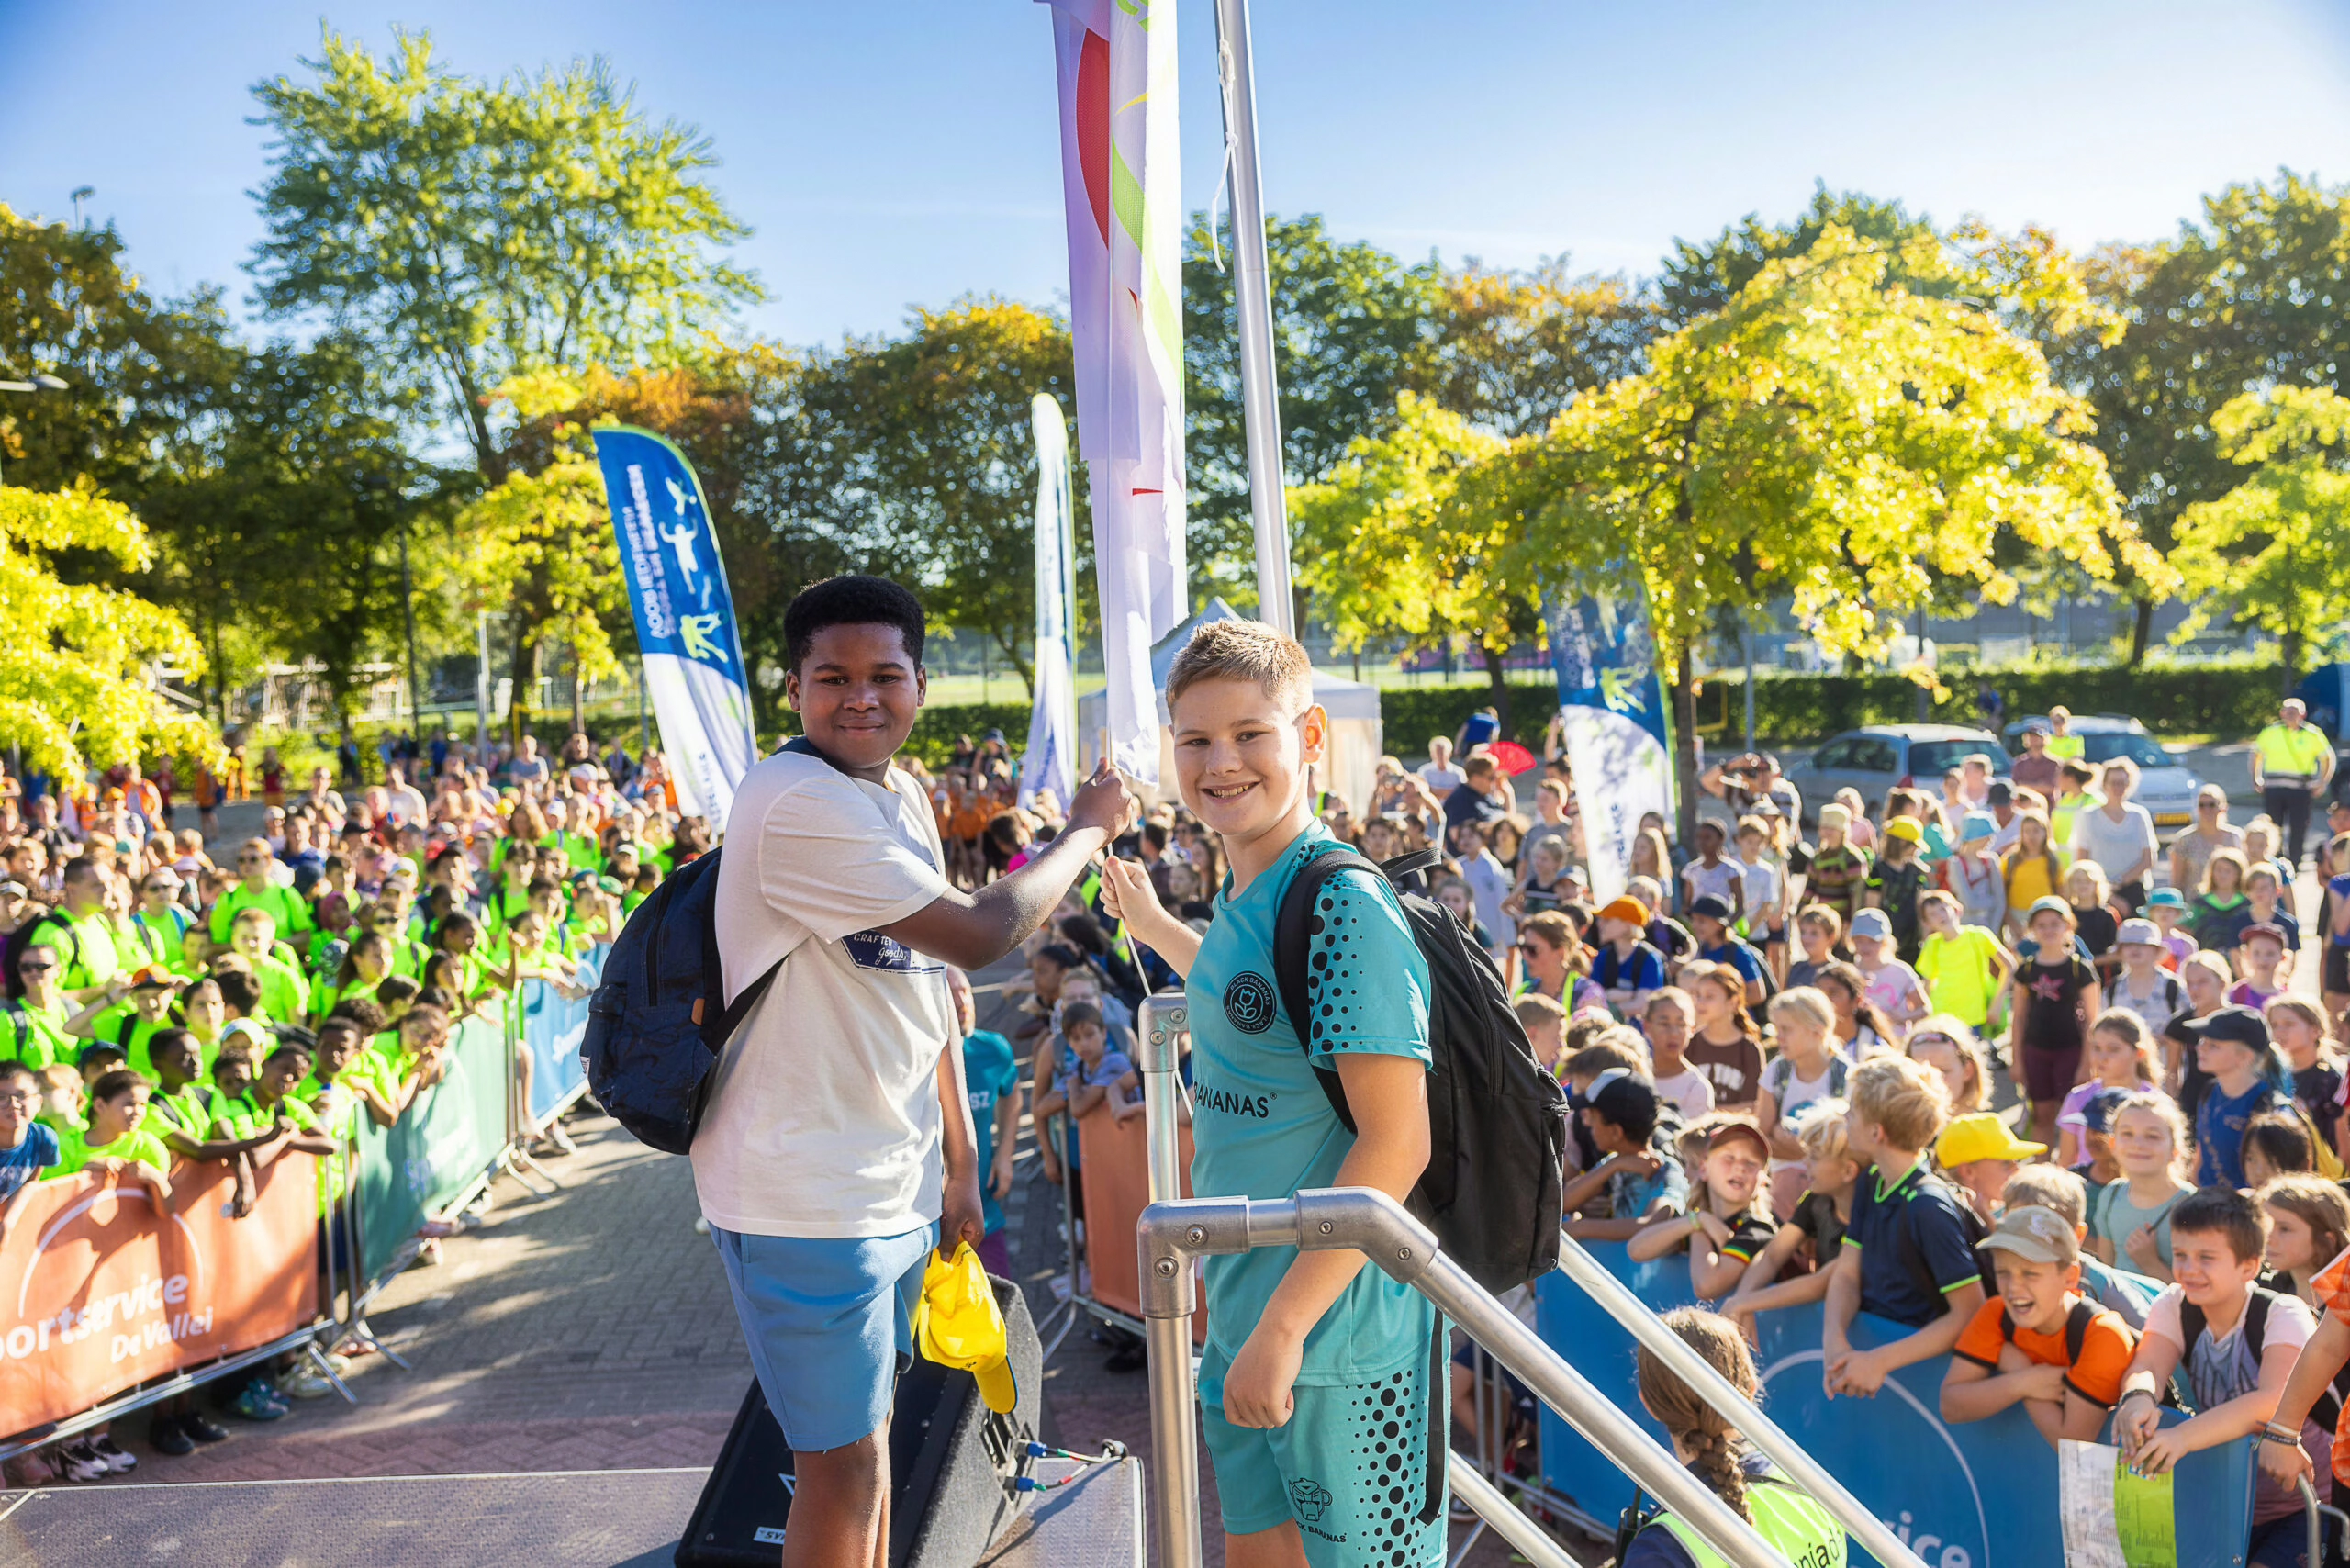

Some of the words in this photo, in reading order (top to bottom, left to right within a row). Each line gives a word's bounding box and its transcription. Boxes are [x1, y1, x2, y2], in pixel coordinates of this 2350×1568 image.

[1230, 977, 1248, 991] BLACK
[1249, 977, 1271, 1006] BANANAS
[111, 1334, 141, 1363] De
[142, 1306, 213, 1350] Vallei
